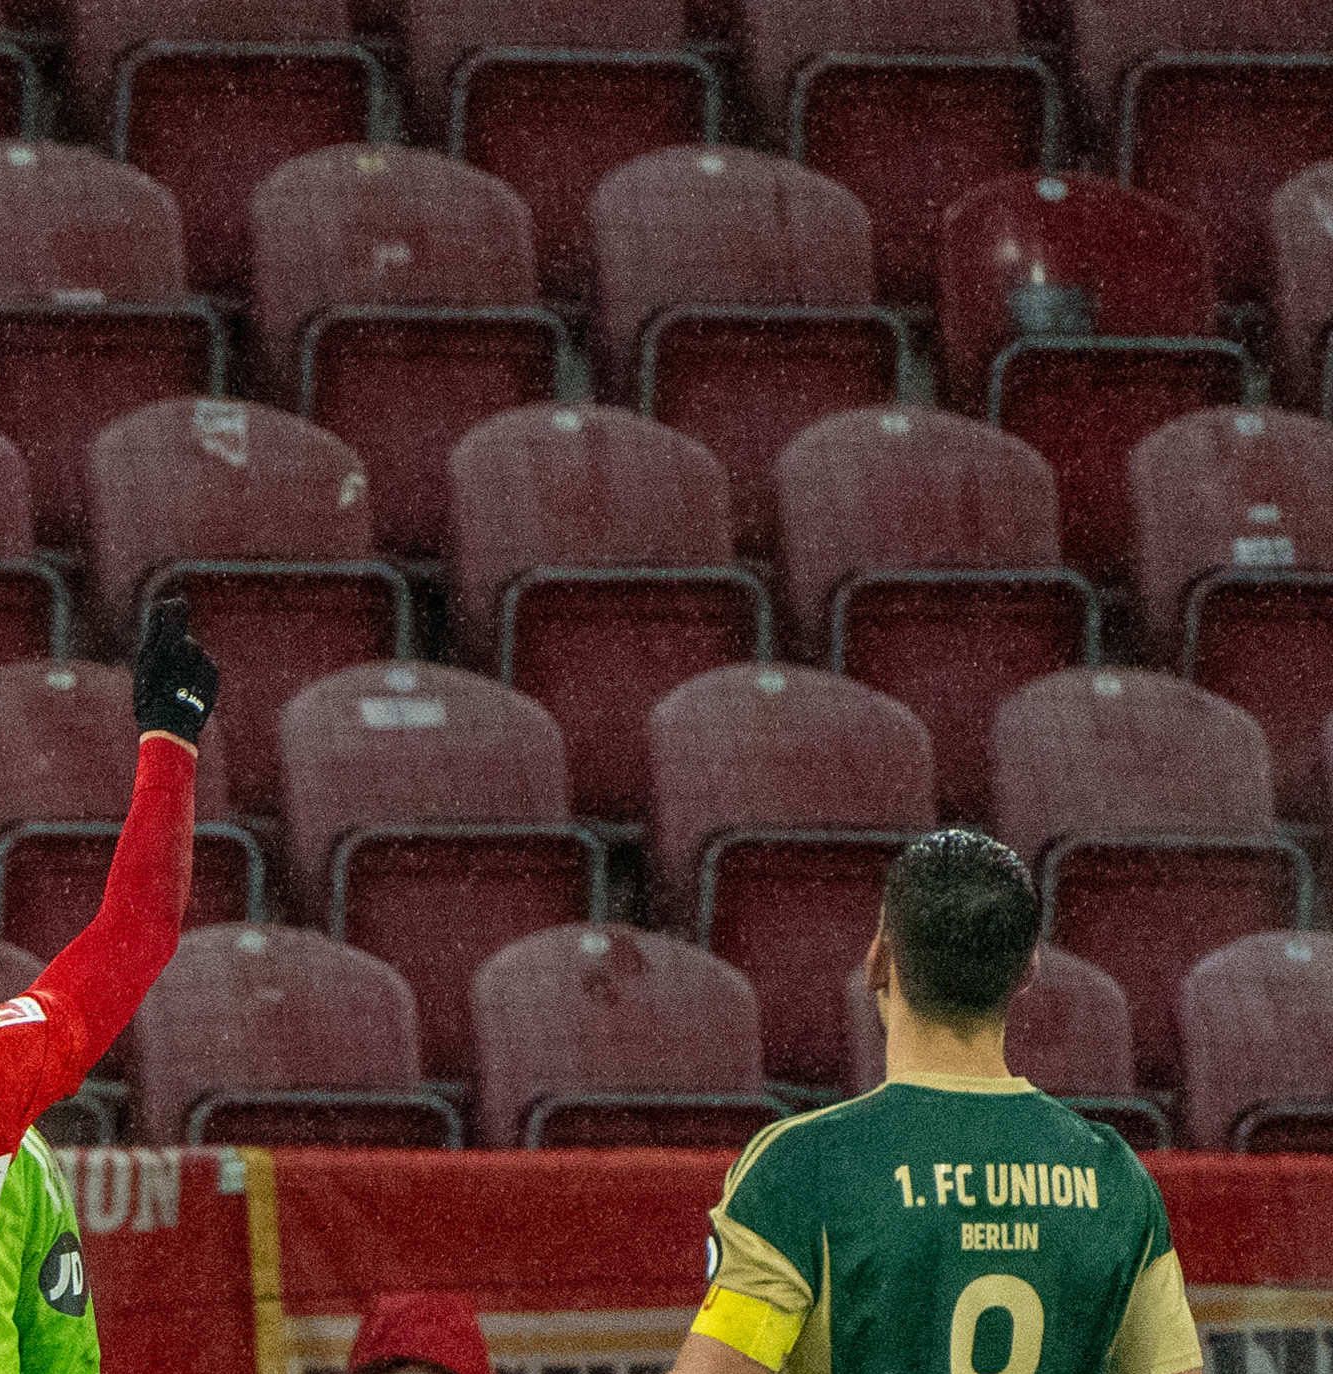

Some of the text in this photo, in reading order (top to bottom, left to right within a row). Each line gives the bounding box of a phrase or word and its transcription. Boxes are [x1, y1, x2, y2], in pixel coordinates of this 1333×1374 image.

[894, 1163, 1099, 1209] 1. FC UNION
[961, 1222, 1039, 1251] BERLIN
[49, 1250, 84, 1302] JD
